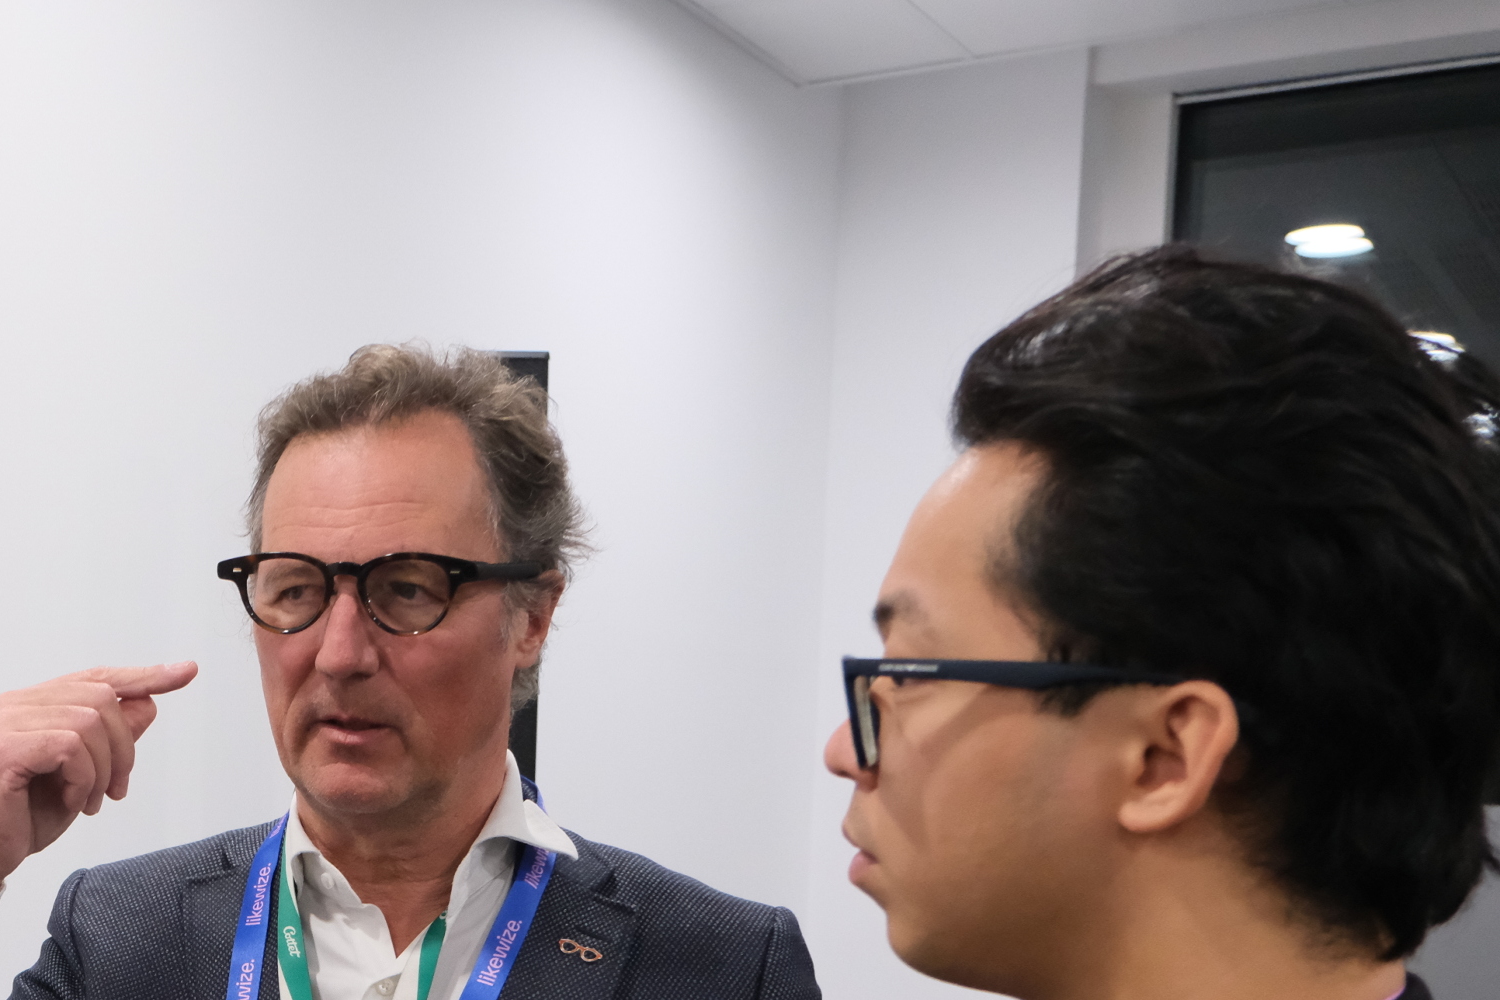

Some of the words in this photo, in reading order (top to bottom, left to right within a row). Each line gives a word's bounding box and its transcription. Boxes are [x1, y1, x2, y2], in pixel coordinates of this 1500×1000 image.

[245, 862, 272, 926] likewize.
[283, 926, 301, 958] Cottet
[476, 919, 523, 987] likewize.
